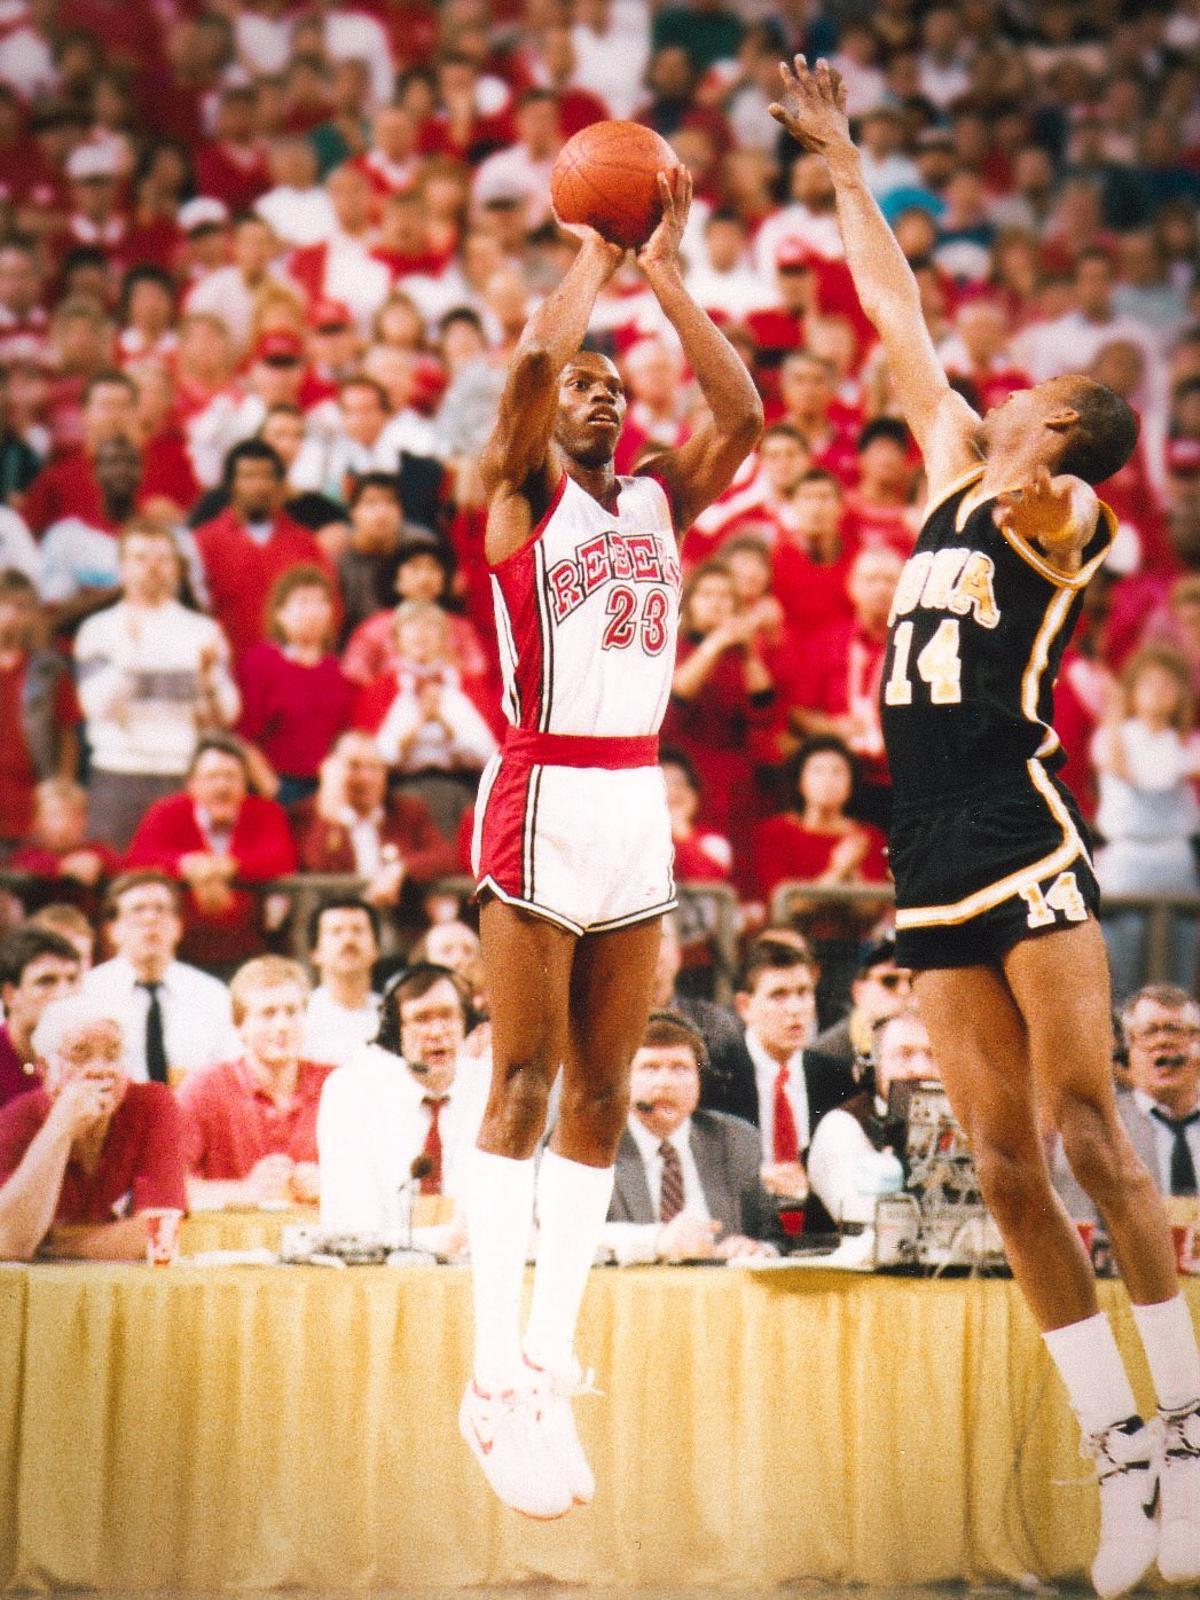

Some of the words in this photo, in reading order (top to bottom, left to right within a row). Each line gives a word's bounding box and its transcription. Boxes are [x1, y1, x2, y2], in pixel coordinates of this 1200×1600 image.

[548, 531, 682, 626] REBEL
[602, 585, 668, 656] 23
[885, 619, 962, 705] 14
[1018, 872, 1088, 929] 14
